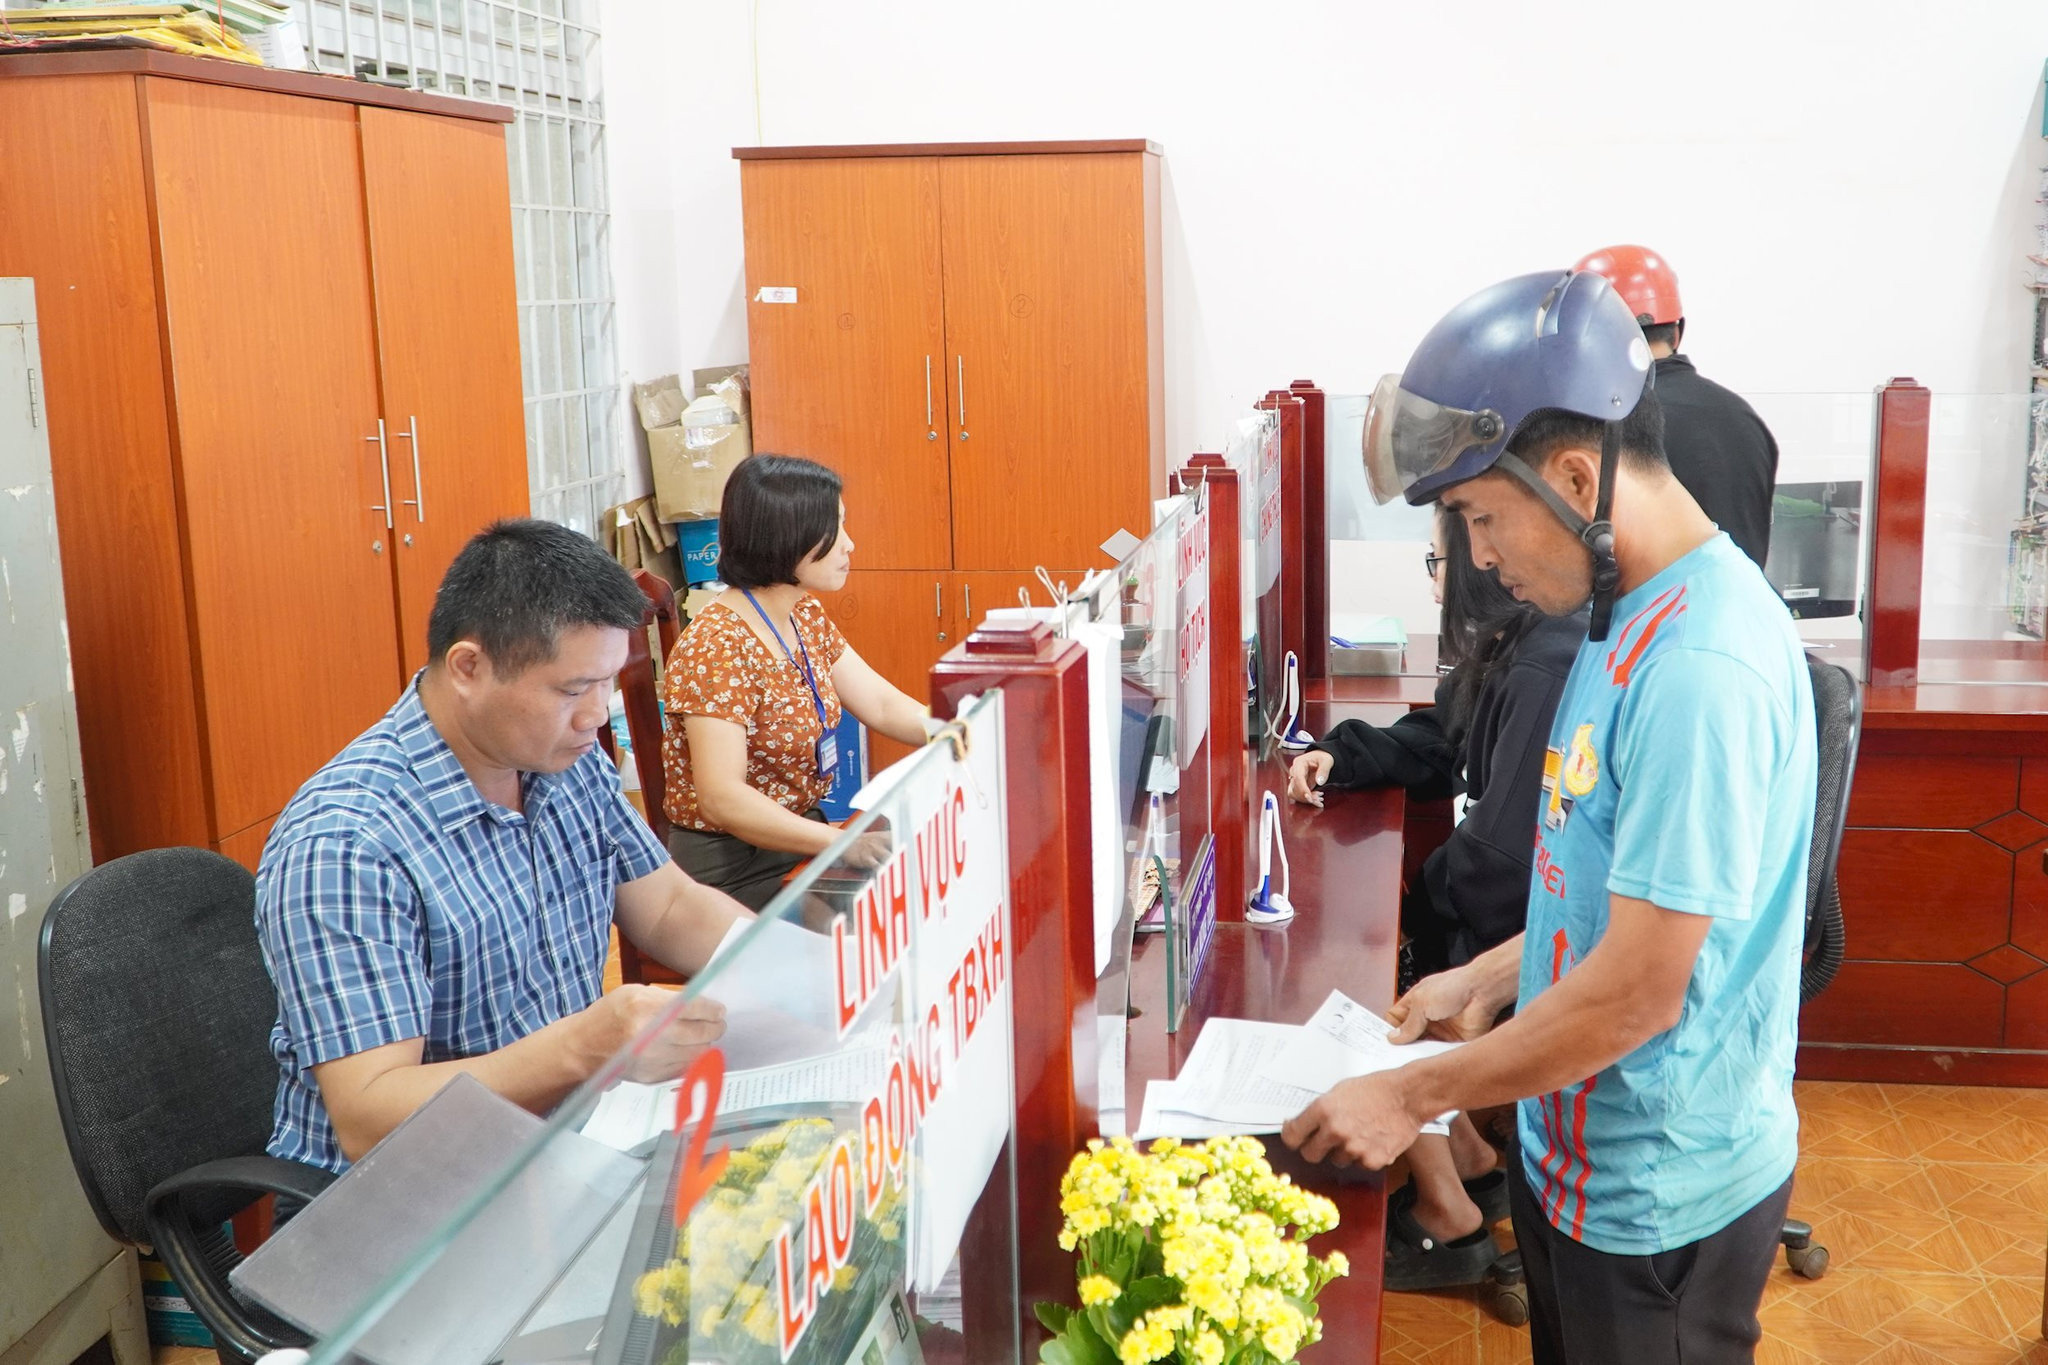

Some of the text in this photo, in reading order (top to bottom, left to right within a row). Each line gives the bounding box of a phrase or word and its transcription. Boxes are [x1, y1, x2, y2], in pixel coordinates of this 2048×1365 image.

[687, 551, 716, 562] PAPER
[674, 1046, 729, 1229] 2
[777, 1143, 852, 1354] LAO
[862, 1003, 942, 1213] ĐỘNG
[948, 902, 1004, 1059] TBXH
